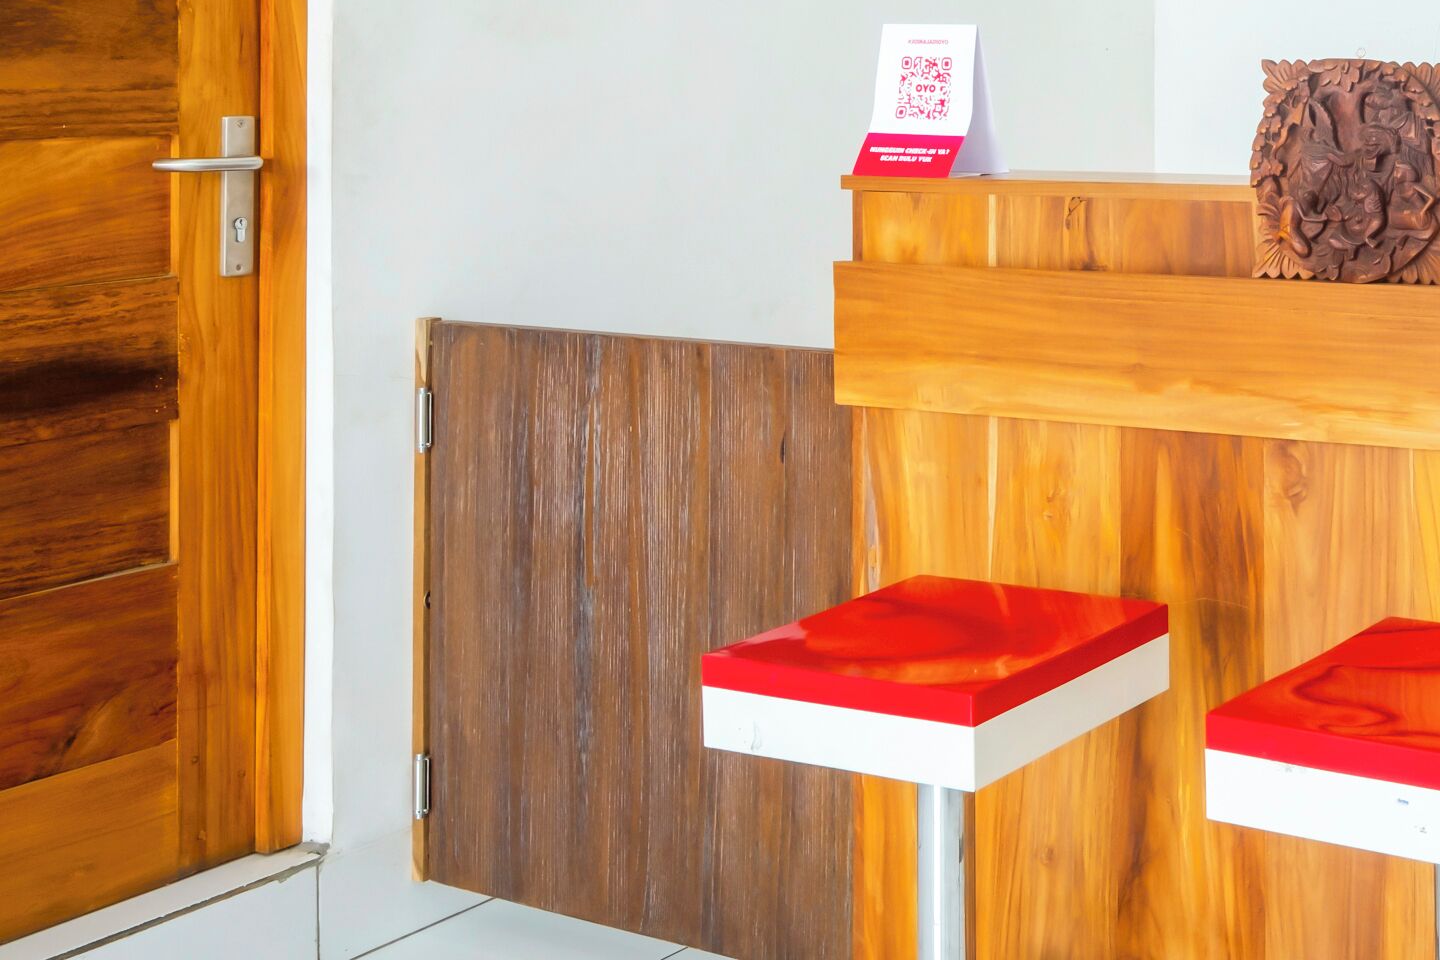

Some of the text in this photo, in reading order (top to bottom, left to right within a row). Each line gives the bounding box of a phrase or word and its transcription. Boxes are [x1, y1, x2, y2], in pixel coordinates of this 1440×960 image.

[915, 84, 936, 93] OYO
[905, 147, 937, 155] CHECK-IN
[879, 154, 899, 162] SCAN
